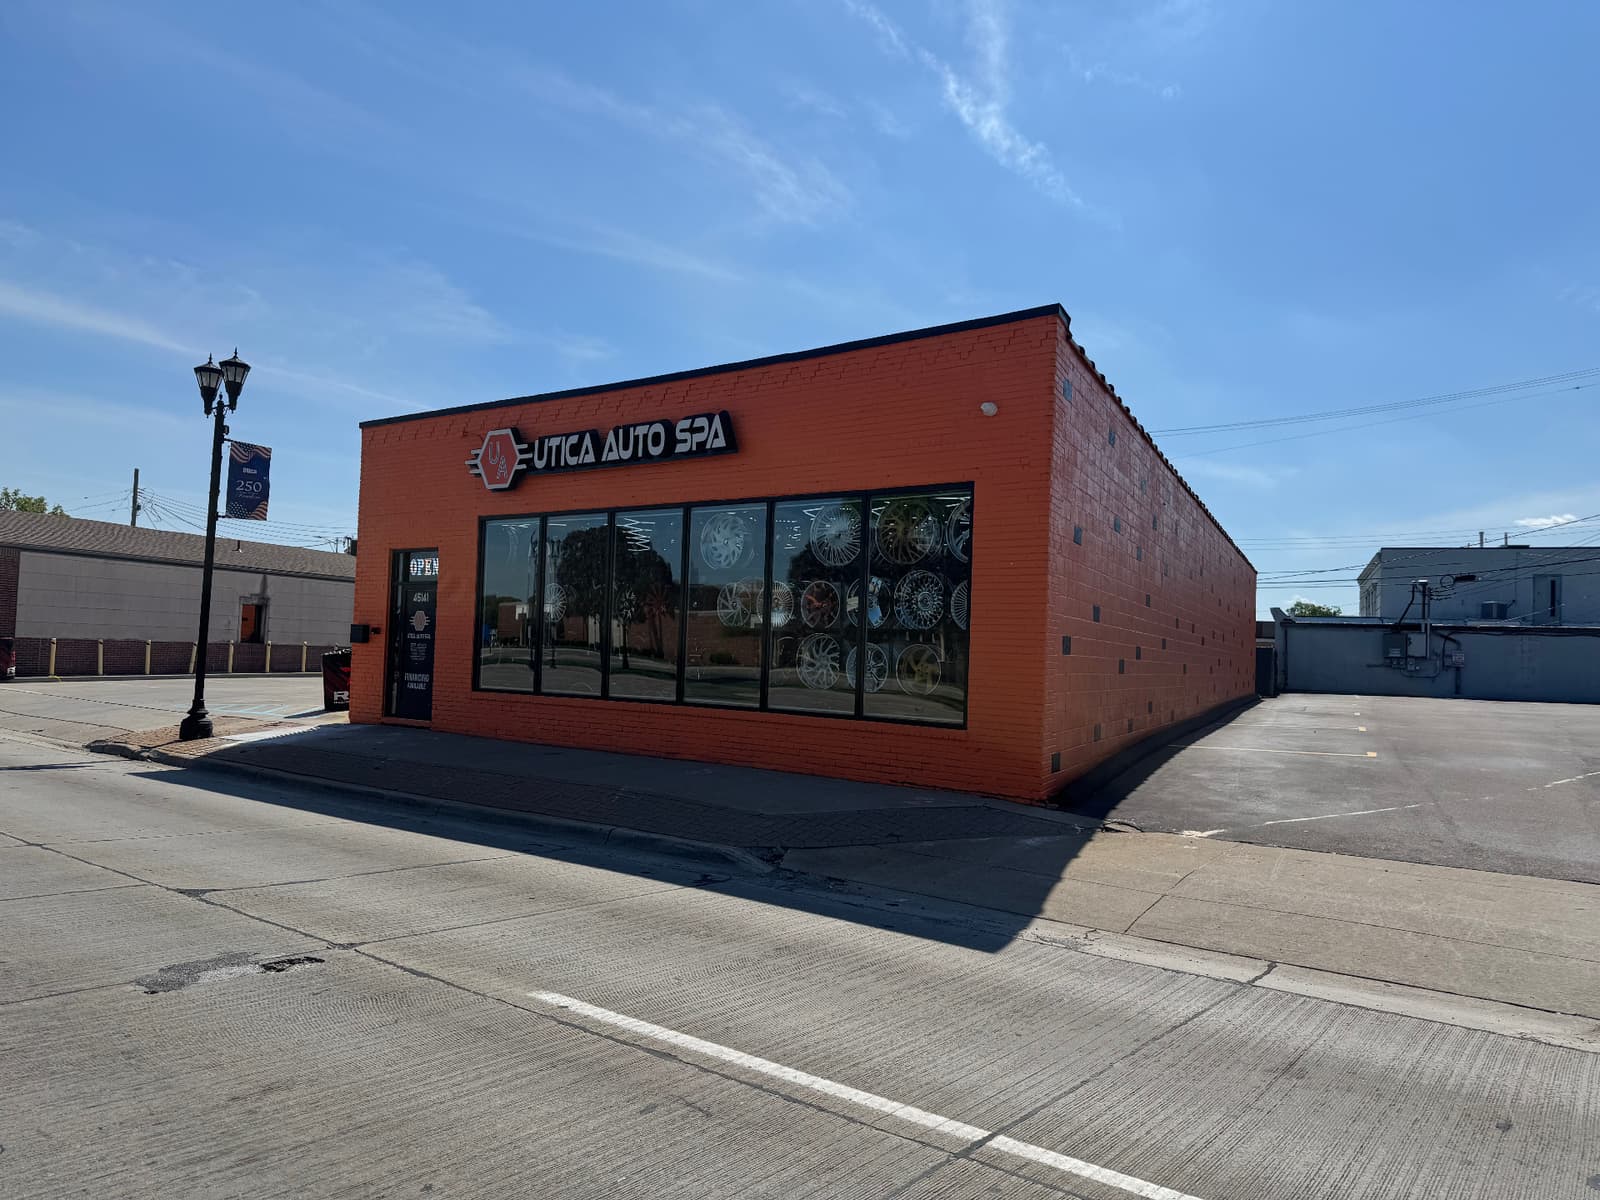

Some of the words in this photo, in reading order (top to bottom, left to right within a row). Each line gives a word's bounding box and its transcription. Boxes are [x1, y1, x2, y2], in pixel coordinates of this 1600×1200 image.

[533, 432, 596, 469] UTICA
[601, 422, 666, 462] AUTO
[674, 414, 727, 454] SPA
[236, 480, 263, 493] 250
[409, 558, 439, 576] OPEN
